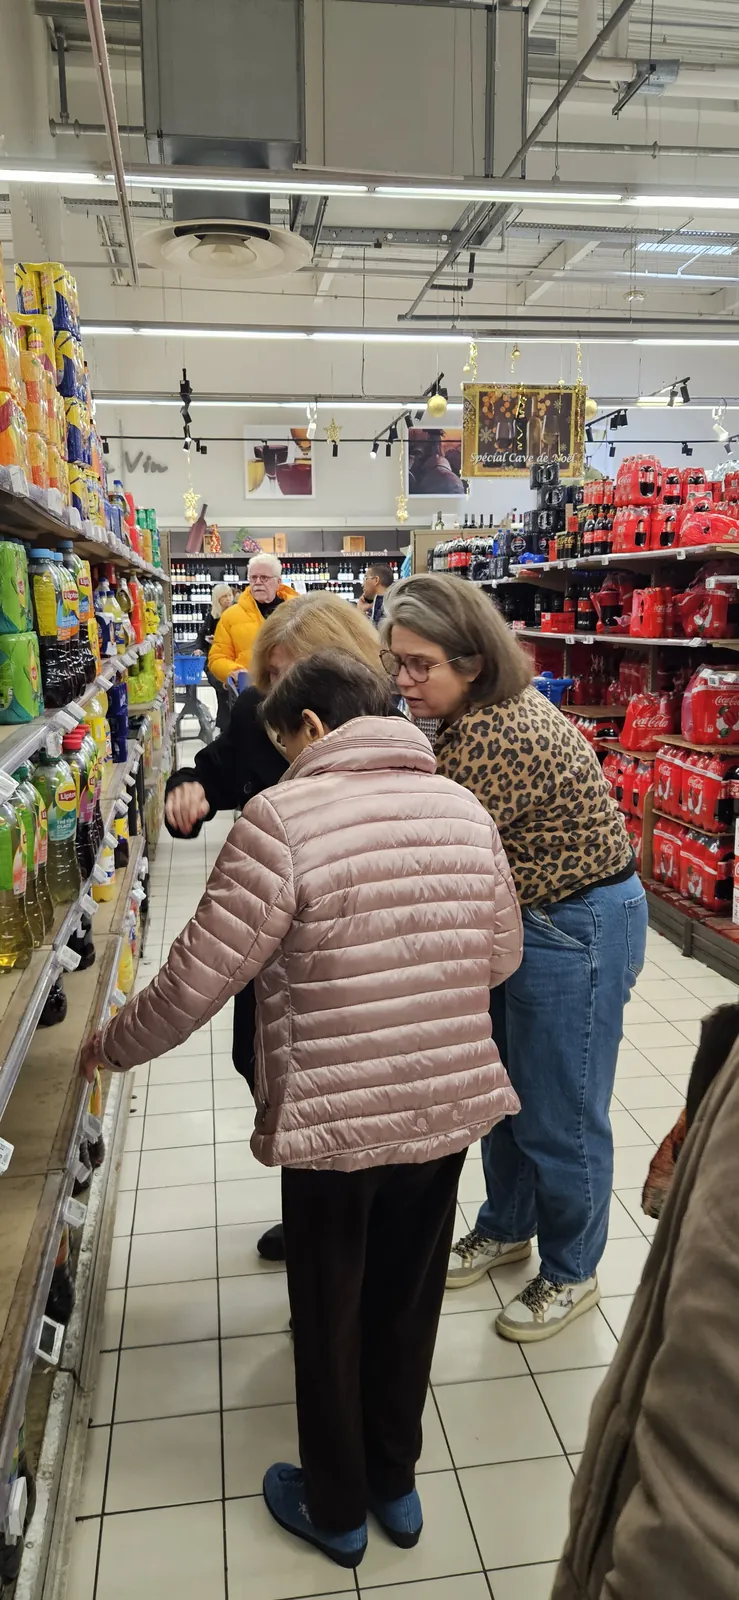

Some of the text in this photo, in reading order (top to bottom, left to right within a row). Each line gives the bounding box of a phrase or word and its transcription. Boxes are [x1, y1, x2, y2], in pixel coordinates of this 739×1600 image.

[125, 451, 169, 473] Vin
[470, 451, 576, 465] Spécial Cave de Noël
